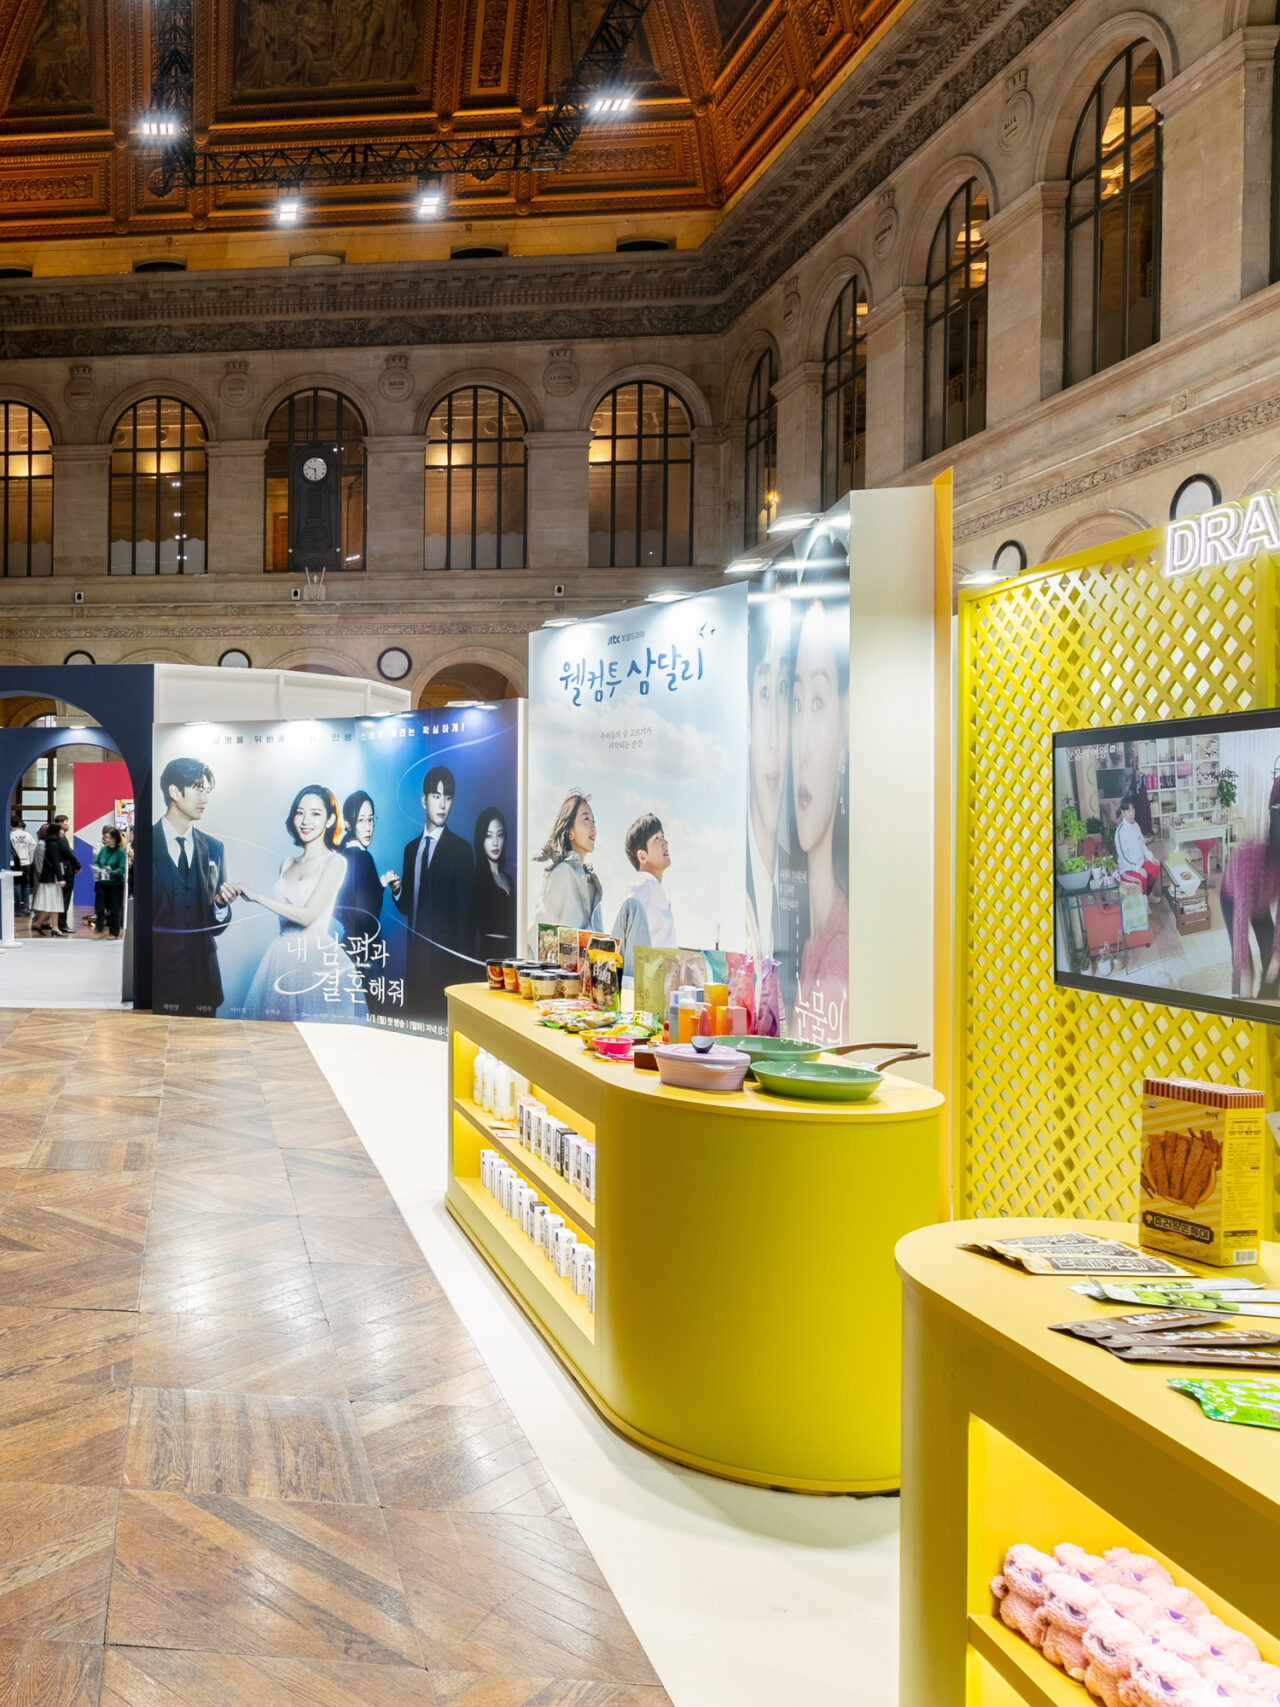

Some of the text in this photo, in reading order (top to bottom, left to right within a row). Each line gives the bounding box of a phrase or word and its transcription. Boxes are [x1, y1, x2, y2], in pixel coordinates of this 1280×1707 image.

[1165, 490, 1280, 575] DRA
[560, 645, 703, 707] 웰컴투 삼달리
[287, 931, 390, 968] 내 남편과
[273, 967, 404, 1008] 결혼해줘
